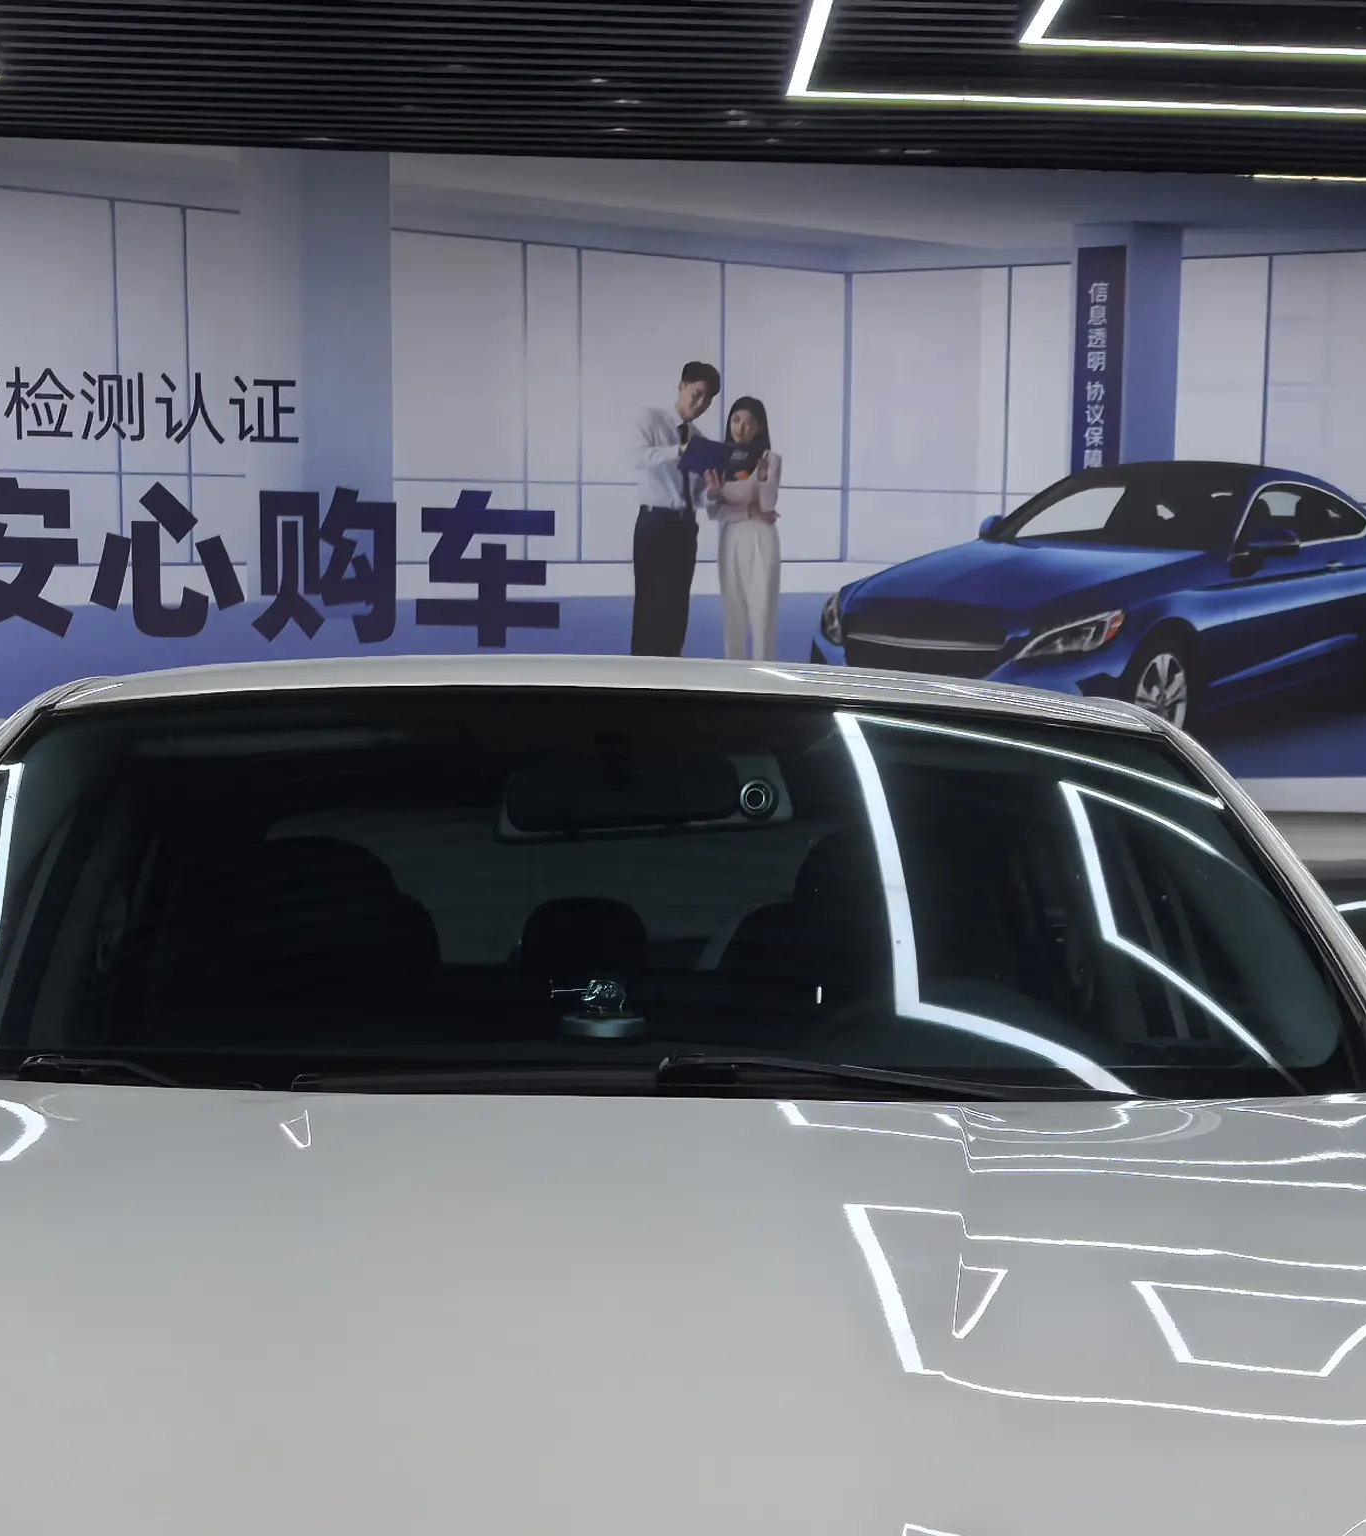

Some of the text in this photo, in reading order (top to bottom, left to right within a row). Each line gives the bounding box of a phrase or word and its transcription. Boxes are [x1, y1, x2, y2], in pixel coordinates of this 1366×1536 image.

[1083, 281, 1110, 470] 信息透明 协议保障
